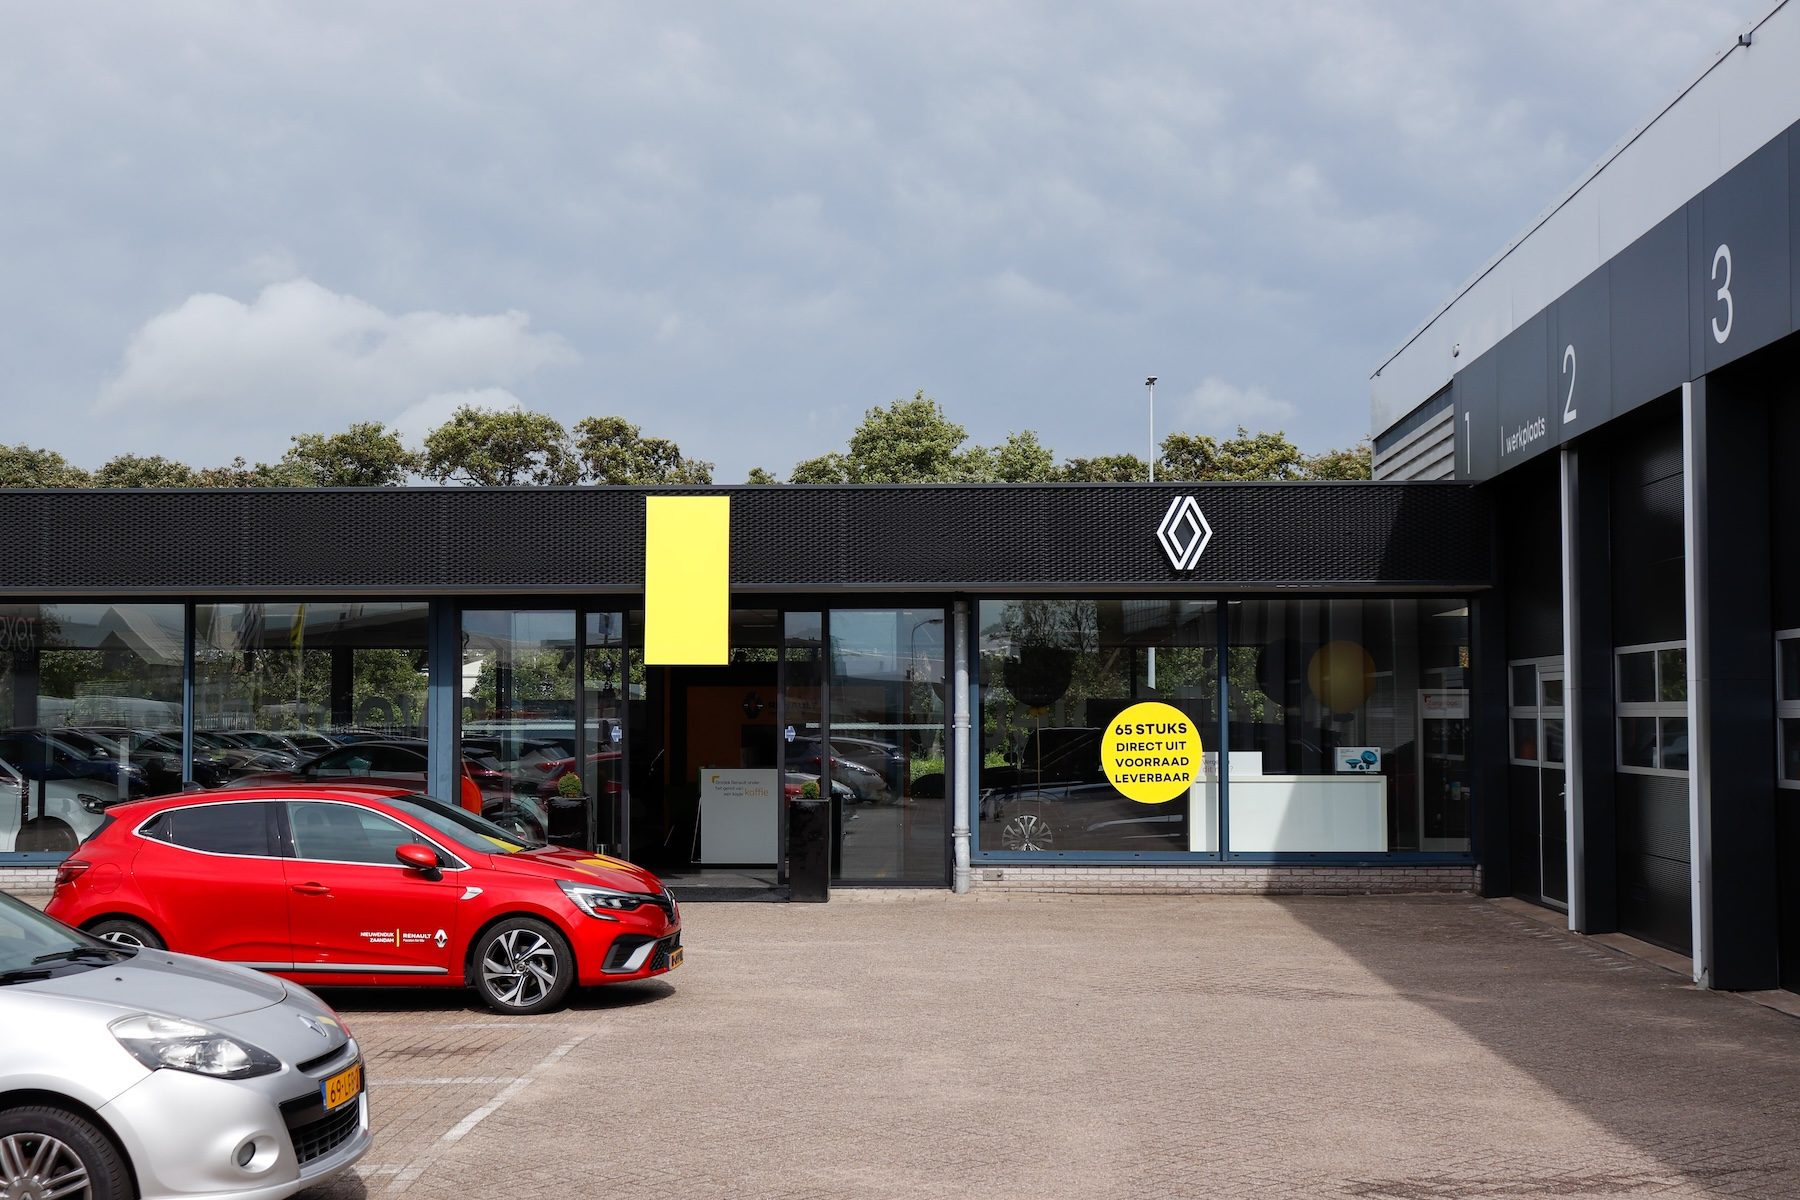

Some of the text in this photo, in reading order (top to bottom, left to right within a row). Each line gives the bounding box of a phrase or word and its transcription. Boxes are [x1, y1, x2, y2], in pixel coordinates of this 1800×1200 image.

[1711, 243, 1734, 345] 3
[1562, 344, 1577, 425] 2
[1464, 411, 1471, 475] 1
[1506, 415, 1546, 455] werkplaats
[1115, 723, 1187, 735] 65 STUKS
[1116, 741, 1187, 752] DIRECT UIT
[1115, 757, 1190, 768] VOORRAAD
[1115, 773, 1190, 783] LEVERBAAR
